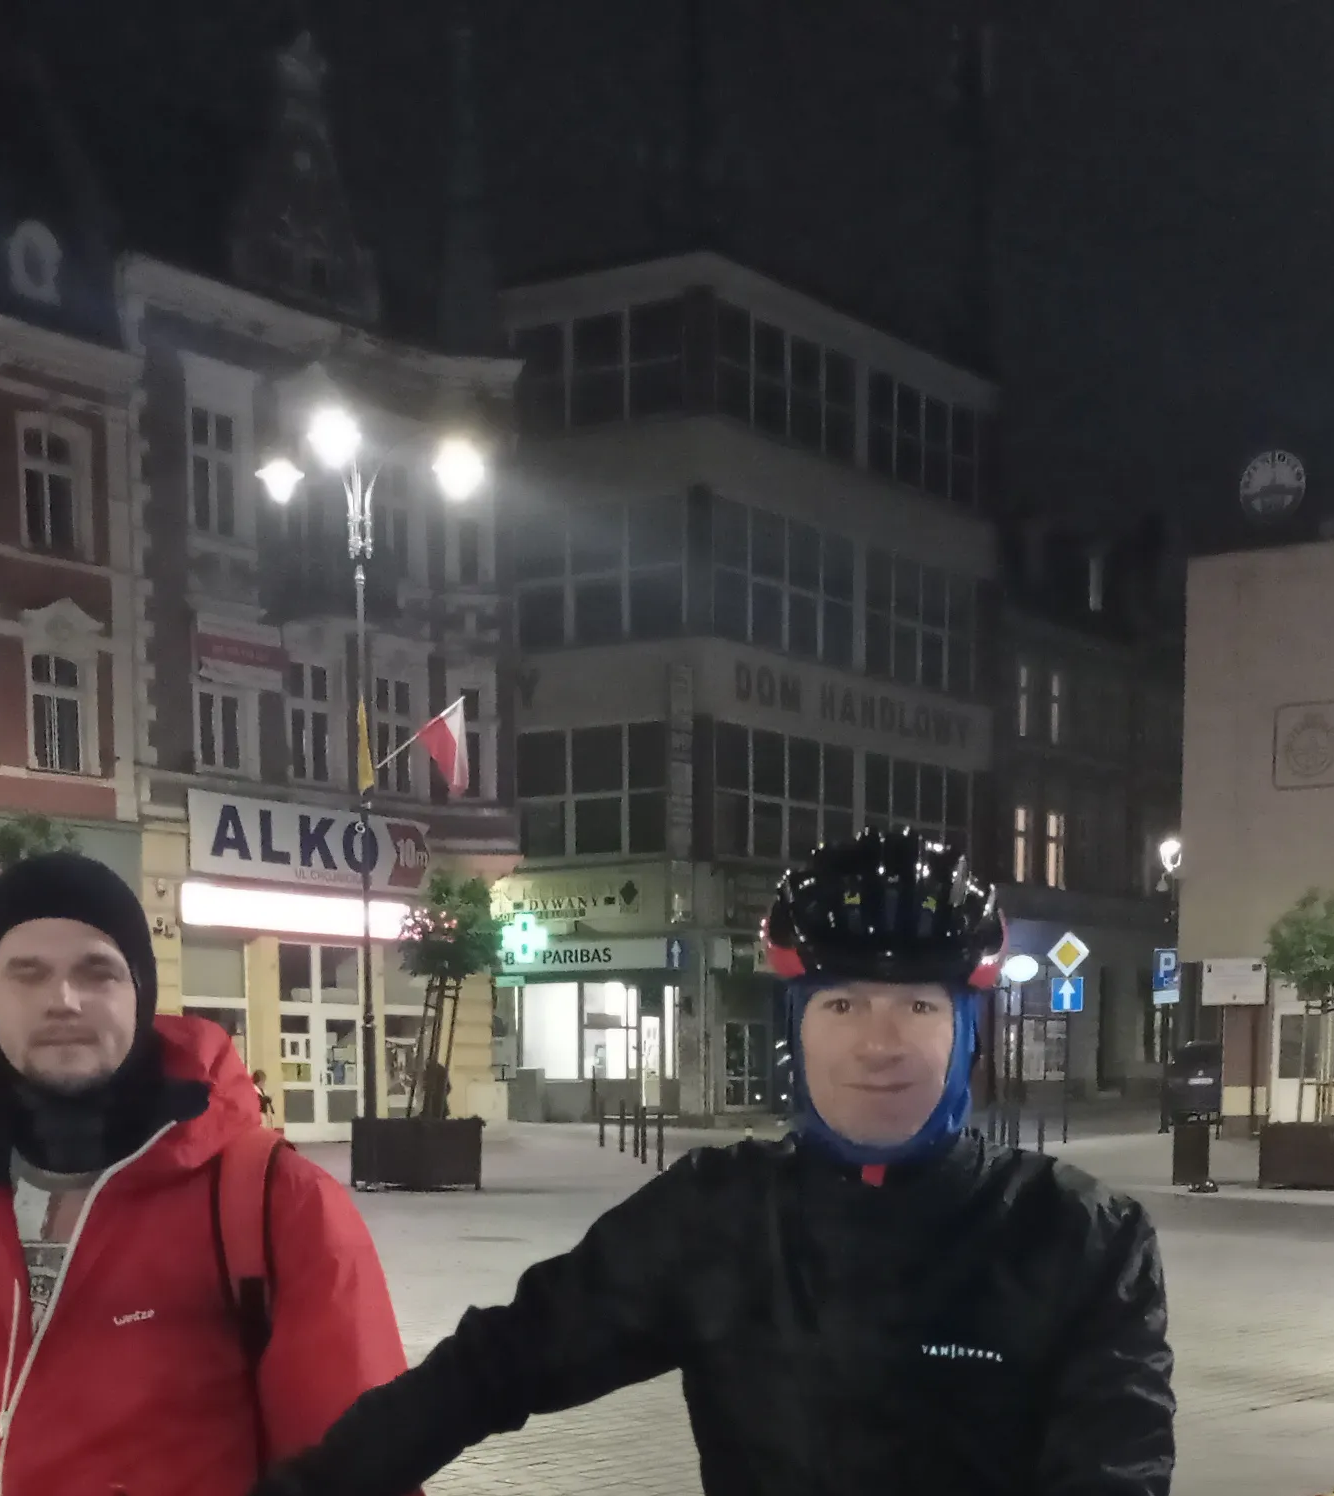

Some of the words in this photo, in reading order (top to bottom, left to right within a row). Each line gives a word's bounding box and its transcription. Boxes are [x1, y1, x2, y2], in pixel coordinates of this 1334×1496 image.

[735, 660, 801, 713] DOM
[820, 680, 972, 748] HANDLOWY
[210, 805, 378, 874] ALKO
[529, 895, 598, 911] DYWANY
[542, 948, 612, 964] PARIBAS
